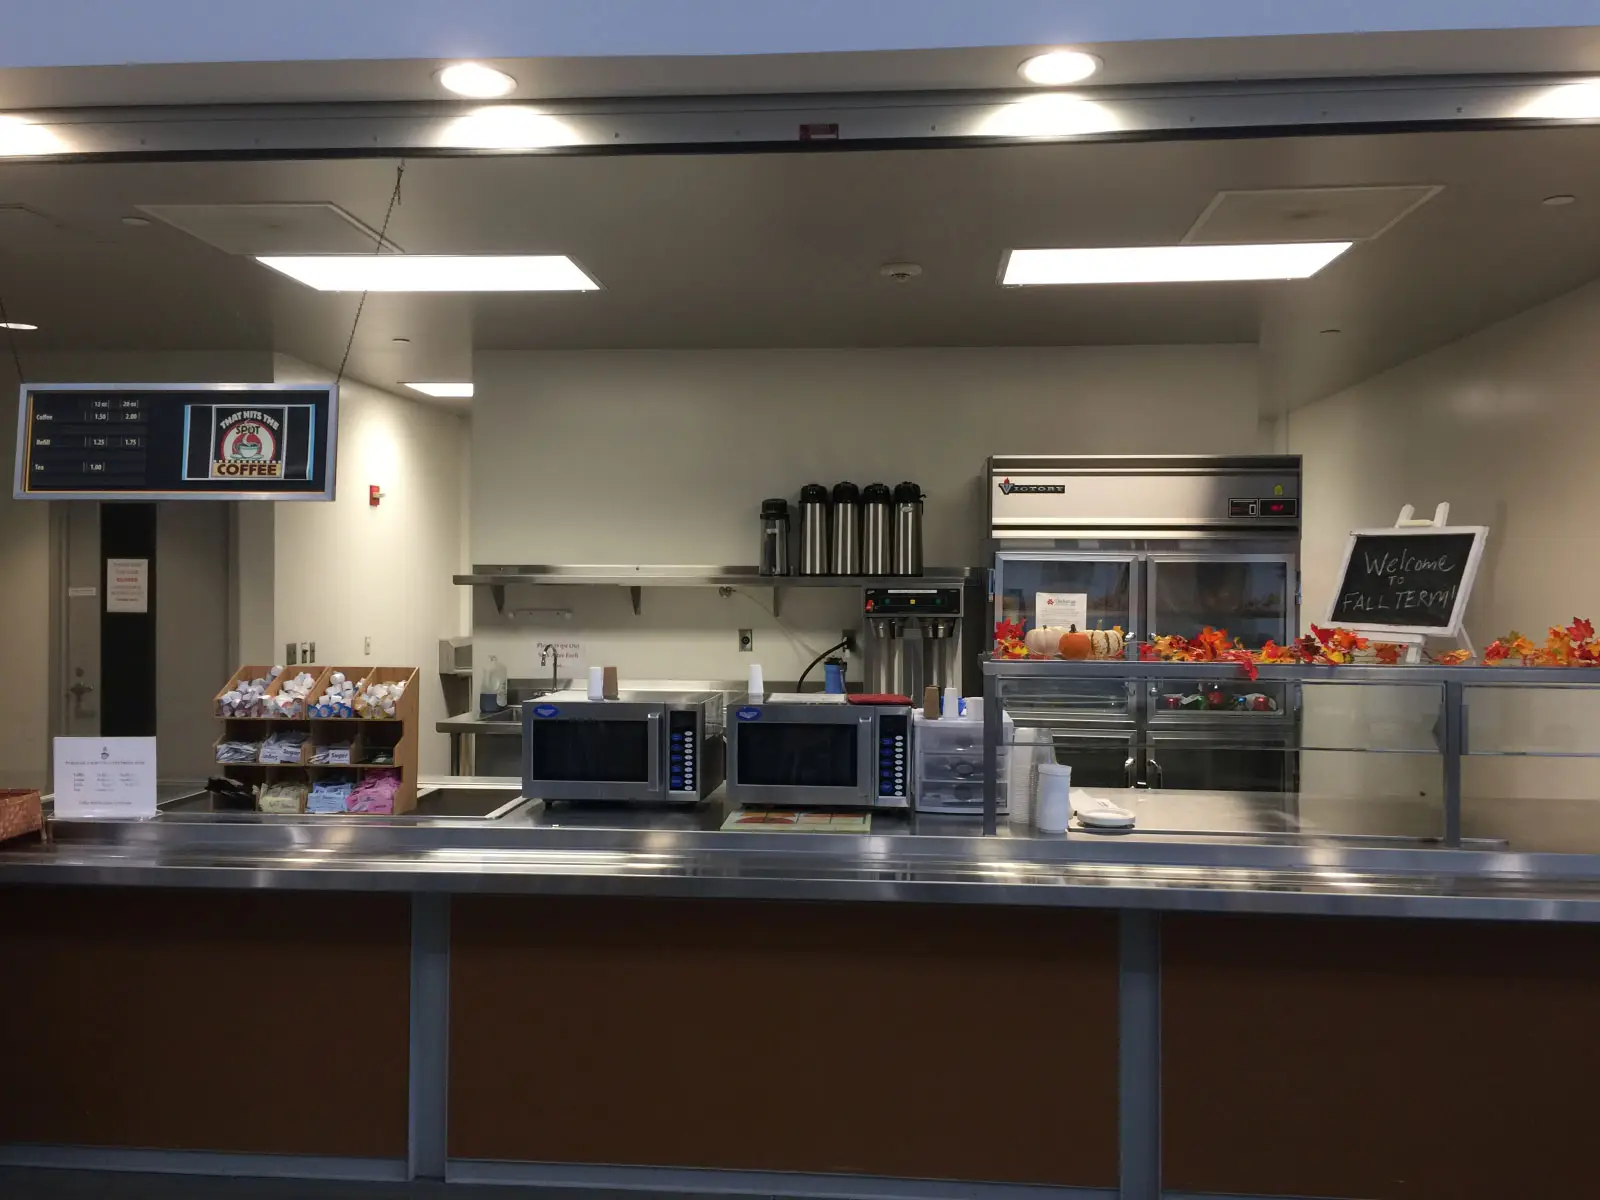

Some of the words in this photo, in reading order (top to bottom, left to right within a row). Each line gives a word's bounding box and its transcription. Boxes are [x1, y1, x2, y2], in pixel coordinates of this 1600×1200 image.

[220, 412, 242, 429] THAT
[243, 411, 262, 420] HITS
[263, 414, 280, 431] THE
[236, 426, 260, 434] SPOT
[217, 464, 277, 476] COFFEE
[998, 483, 1064, 495] VICTORY
[1364, 548, 1456, 576] Welcome
[1388, 575, 1405, 586] TO
[1343, 591, 1390, 612] FALL
